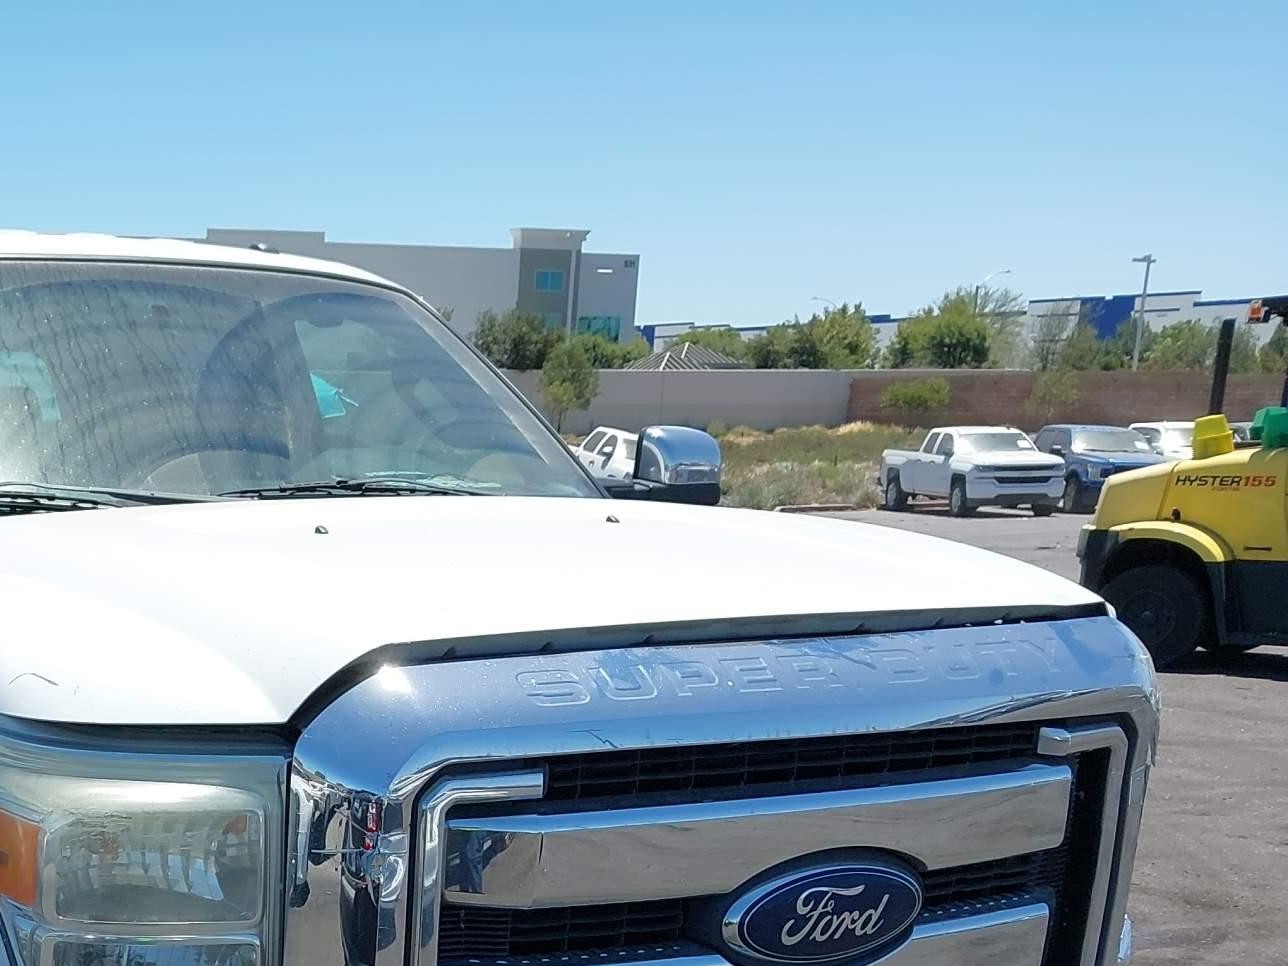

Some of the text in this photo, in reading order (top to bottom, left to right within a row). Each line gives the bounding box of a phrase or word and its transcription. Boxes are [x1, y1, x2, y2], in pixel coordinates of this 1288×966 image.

[515, 637, 1060, 706] SUPER DUTY
[781, 884, 890, 946] Ford
